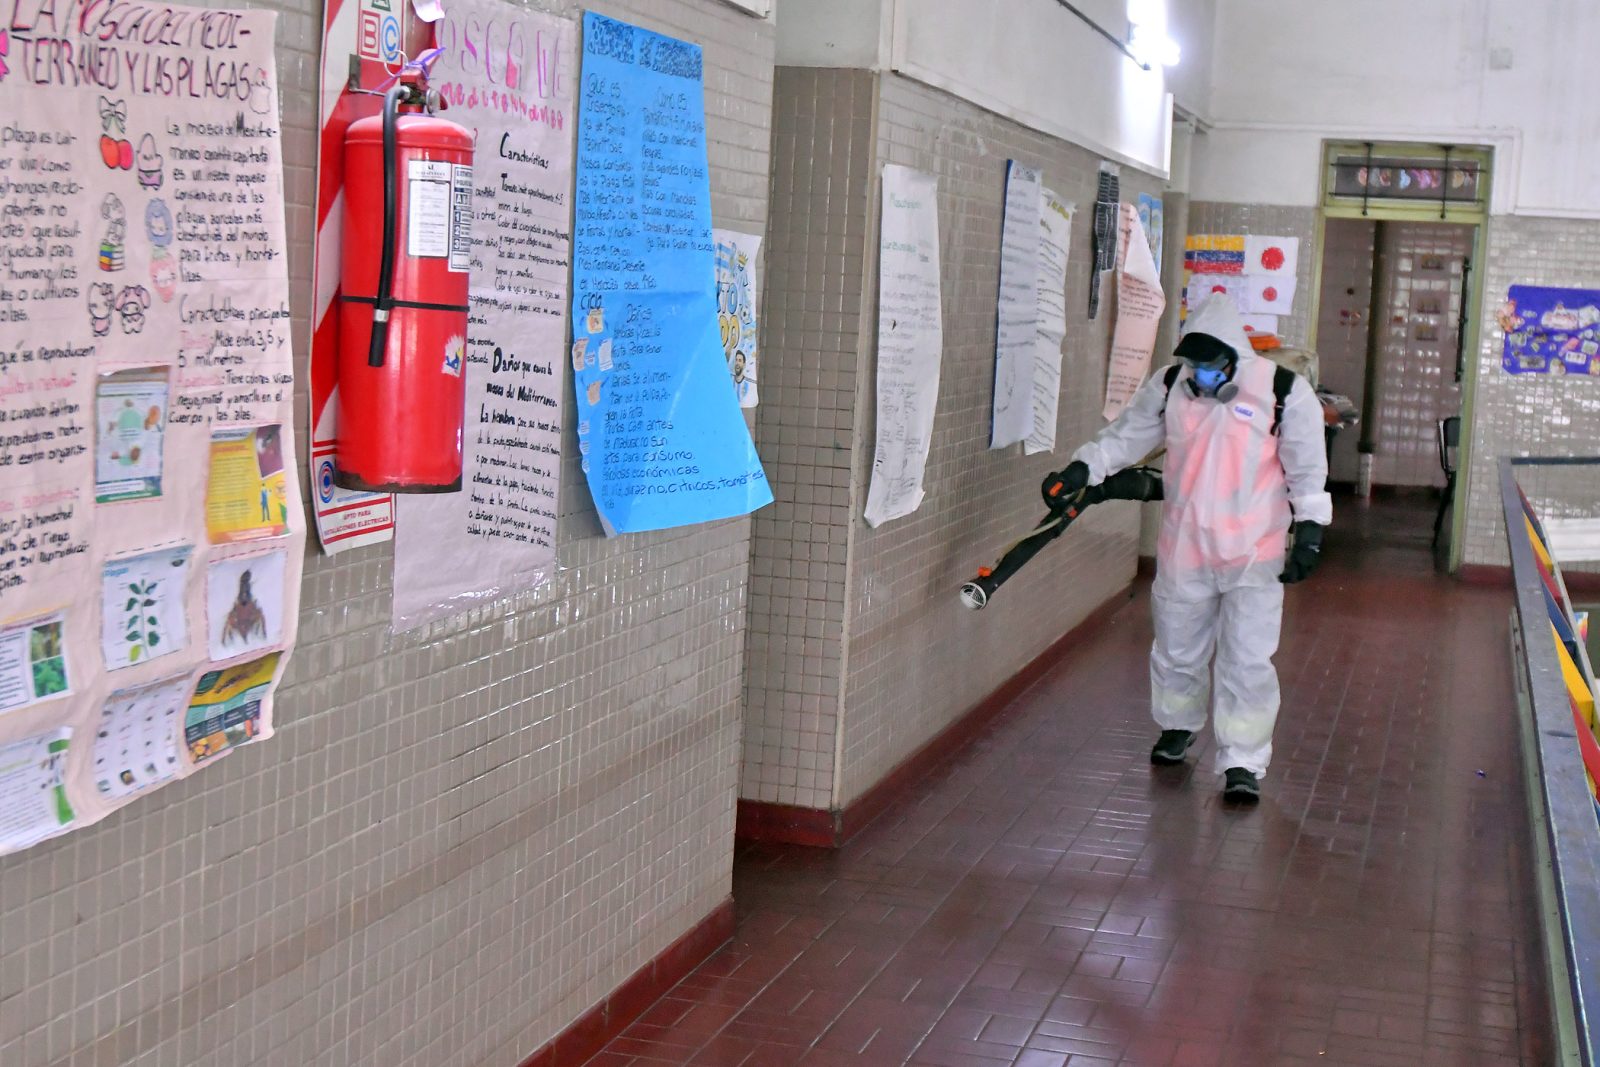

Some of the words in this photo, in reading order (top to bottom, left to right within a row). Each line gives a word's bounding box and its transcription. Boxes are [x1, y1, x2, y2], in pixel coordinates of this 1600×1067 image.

[9, 0, 57, 32] LA
[364, 19, 377, 49] B
[385, 24, 396, 52] C
[441, 8, 528, 92] OSCA
[124, 50, 140, 96] Y
[142, 52, 174, 96] LAS
[176, 56, 251, 101] PLAGAS
[165, 115, 181, 136] La
[492, 347, 521, 374] Daños
[522, 361, 532, 379] que
[487, 383, 504, 397] mosca
[506, 384, 515, 399] del
[480, 403, 489, 423] La
[491, 408, 516, 426] hembra
[357, 515, 389, 528] ELECTRICAS
